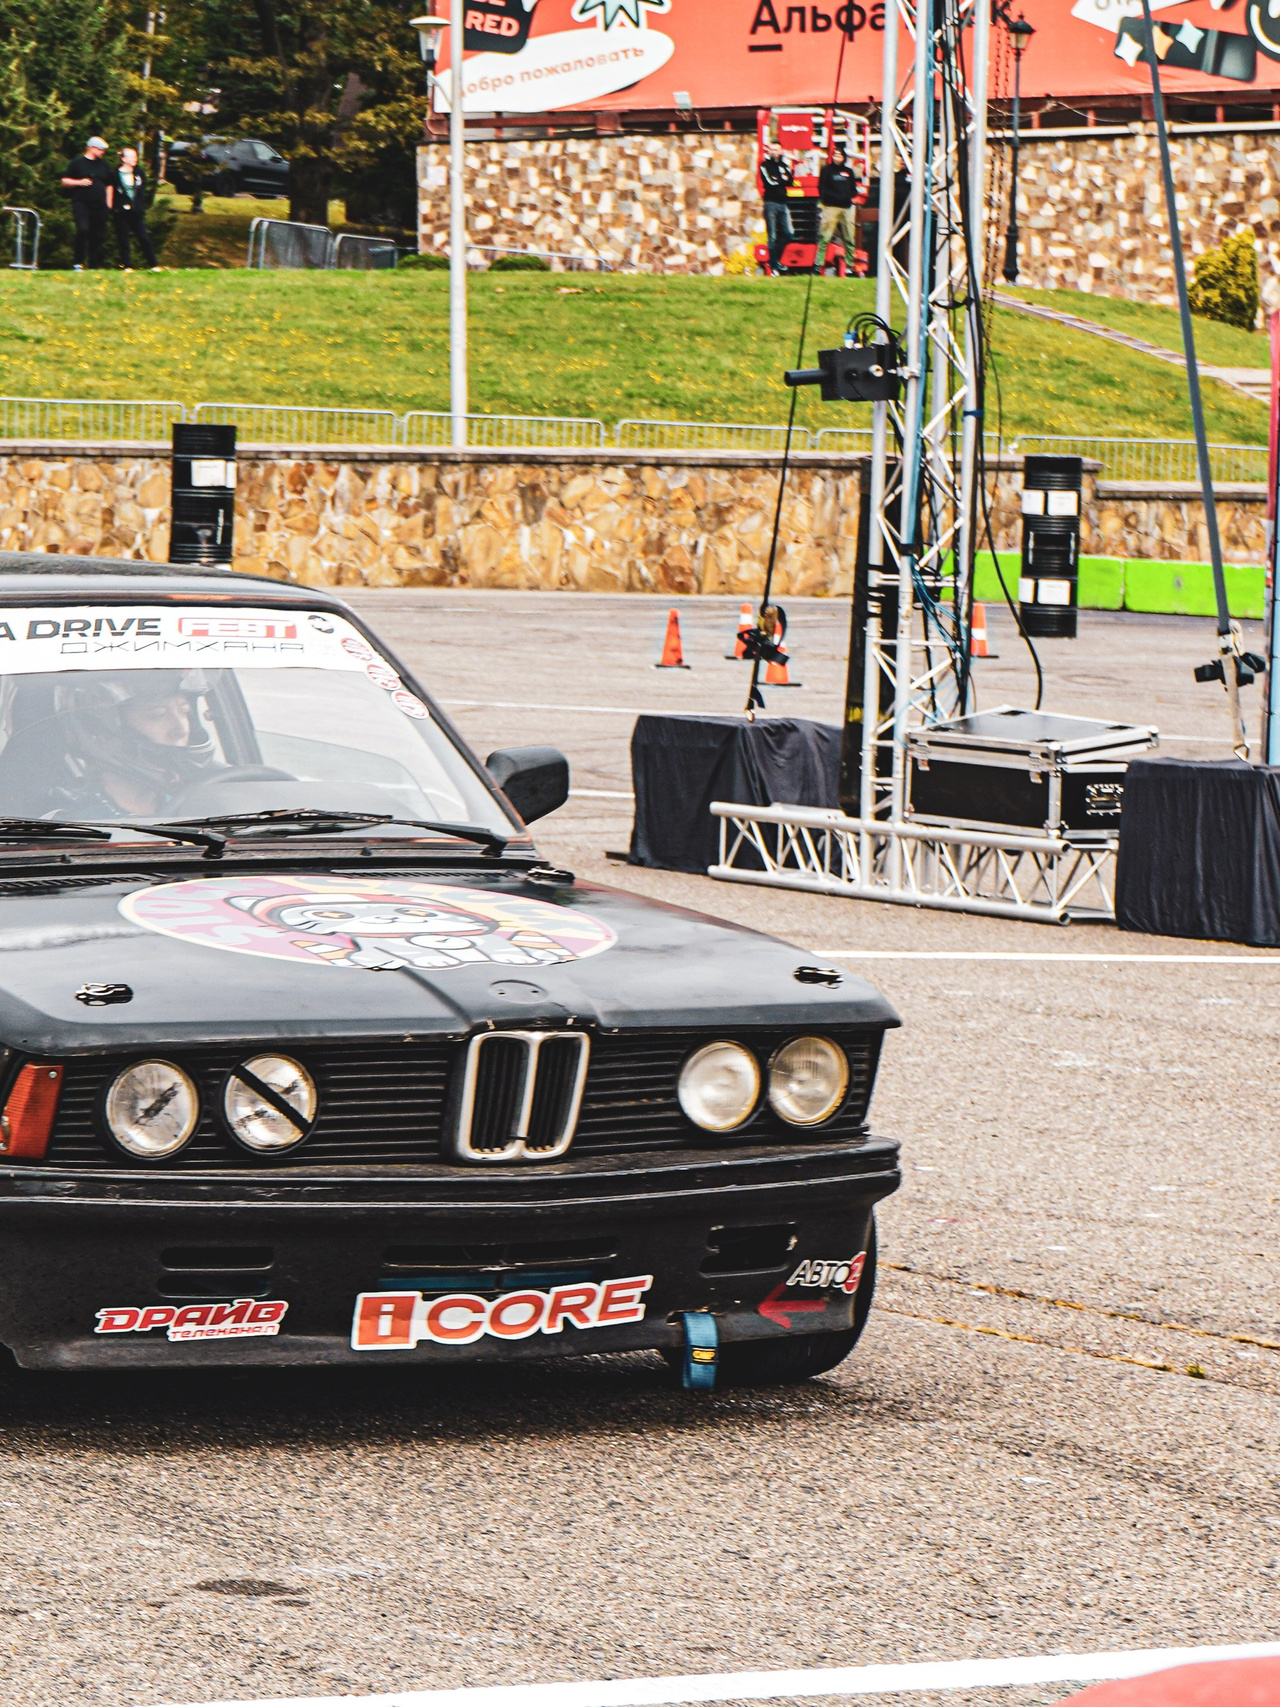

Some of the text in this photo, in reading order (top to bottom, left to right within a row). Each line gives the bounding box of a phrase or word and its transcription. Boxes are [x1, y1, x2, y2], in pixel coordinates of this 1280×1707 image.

[465, 9, 520, 37] RED
[461, 47, 645, 97] обро пожаловать
[26, 618, 161, 640] DRIVE
[60, 641, 305, 654] ДЖИМХАНА
